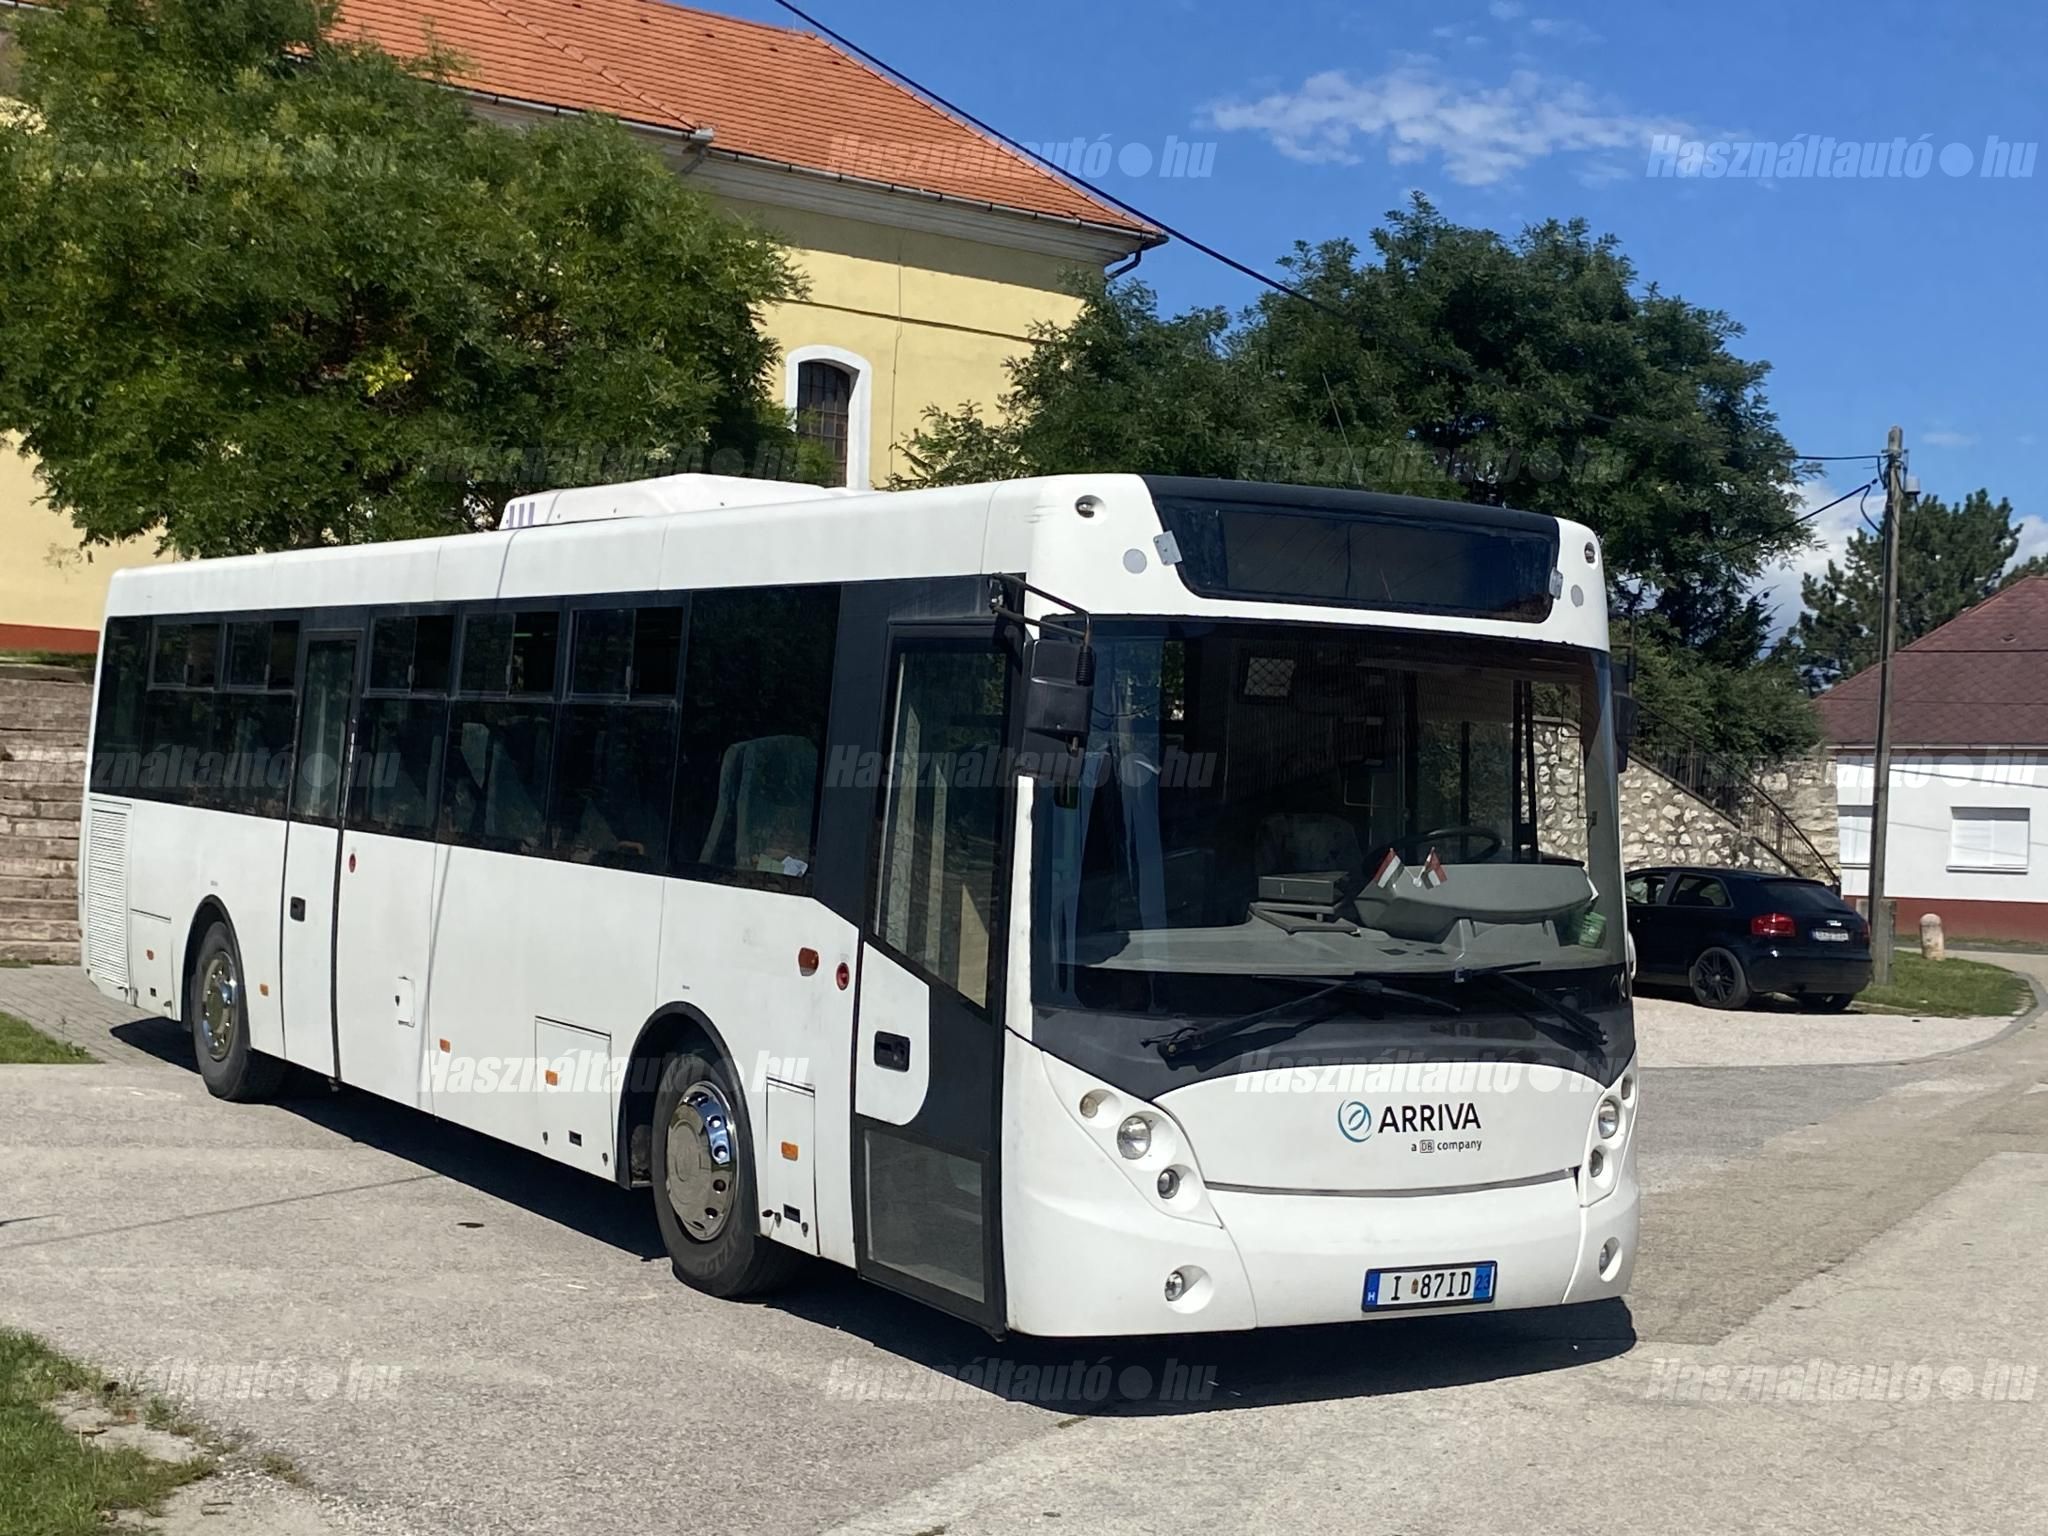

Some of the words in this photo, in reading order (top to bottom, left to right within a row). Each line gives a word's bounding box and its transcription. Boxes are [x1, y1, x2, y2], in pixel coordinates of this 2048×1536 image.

[1378, 1102, 1481, 1133] ARRIVA
[1411, 1143, 1418, 1152] a
[1421, 1141, 1433, 1152] DB
[1437, 1140, 1482, 1152] company
[1368, 1291, 1376, 1301] H
[1420, 1271, 1471, 1299] 87ID
